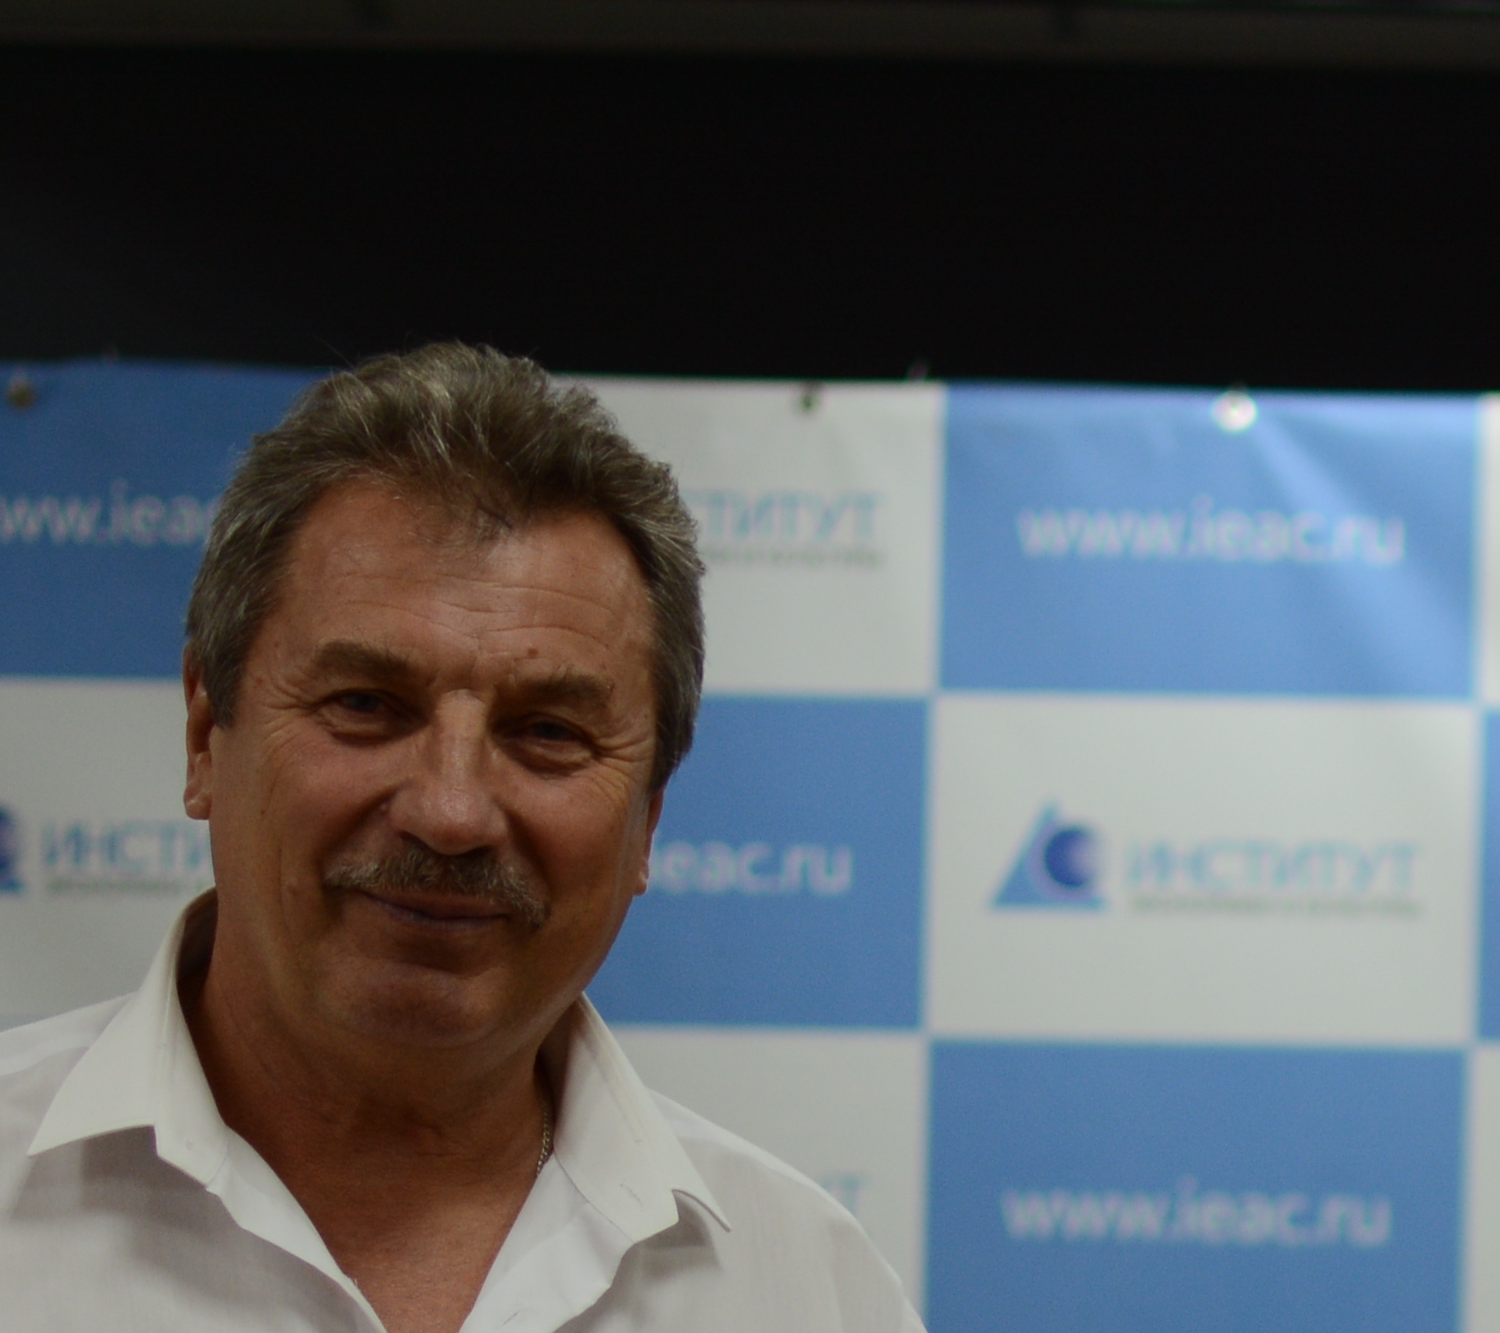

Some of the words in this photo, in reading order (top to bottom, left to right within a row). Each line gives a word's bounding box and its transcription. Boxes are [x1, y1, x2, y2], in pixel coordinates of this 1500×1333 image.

[1019, 494, 1405, 565] www.ieac.ru
[41, 820, 212, 873] ИНСТИ
[1127, 837, 1421, 891] ИНСТИТУТ
[1005, 1178, 1391, 1247] www.ieac.ru
